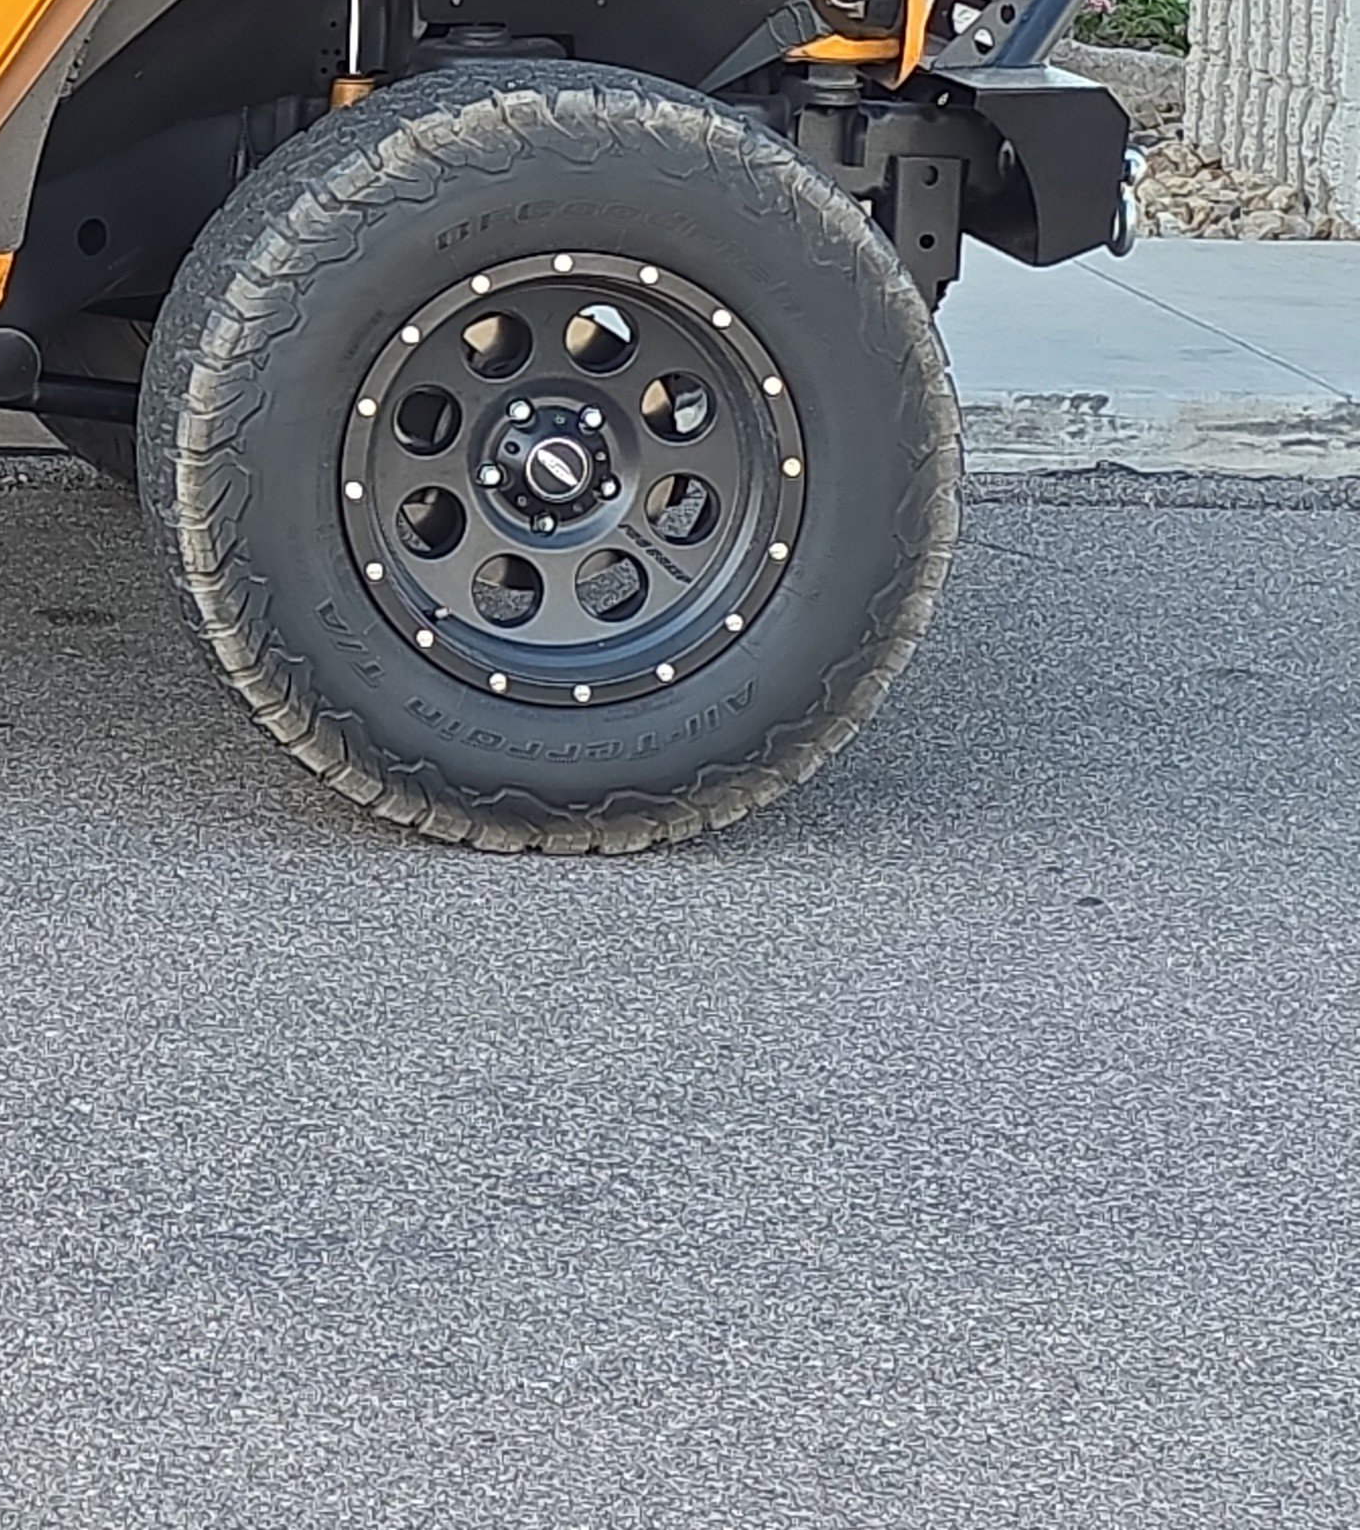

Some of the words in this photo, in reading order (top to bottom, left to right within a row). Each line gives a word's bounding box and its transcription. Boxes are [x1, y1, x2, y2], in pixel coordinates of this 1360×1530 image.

[437, 199, 803, 316] BFGoodrich
[316, 602, 391, 686] T/A
[404, 679, 757, 766] All-Terrain
